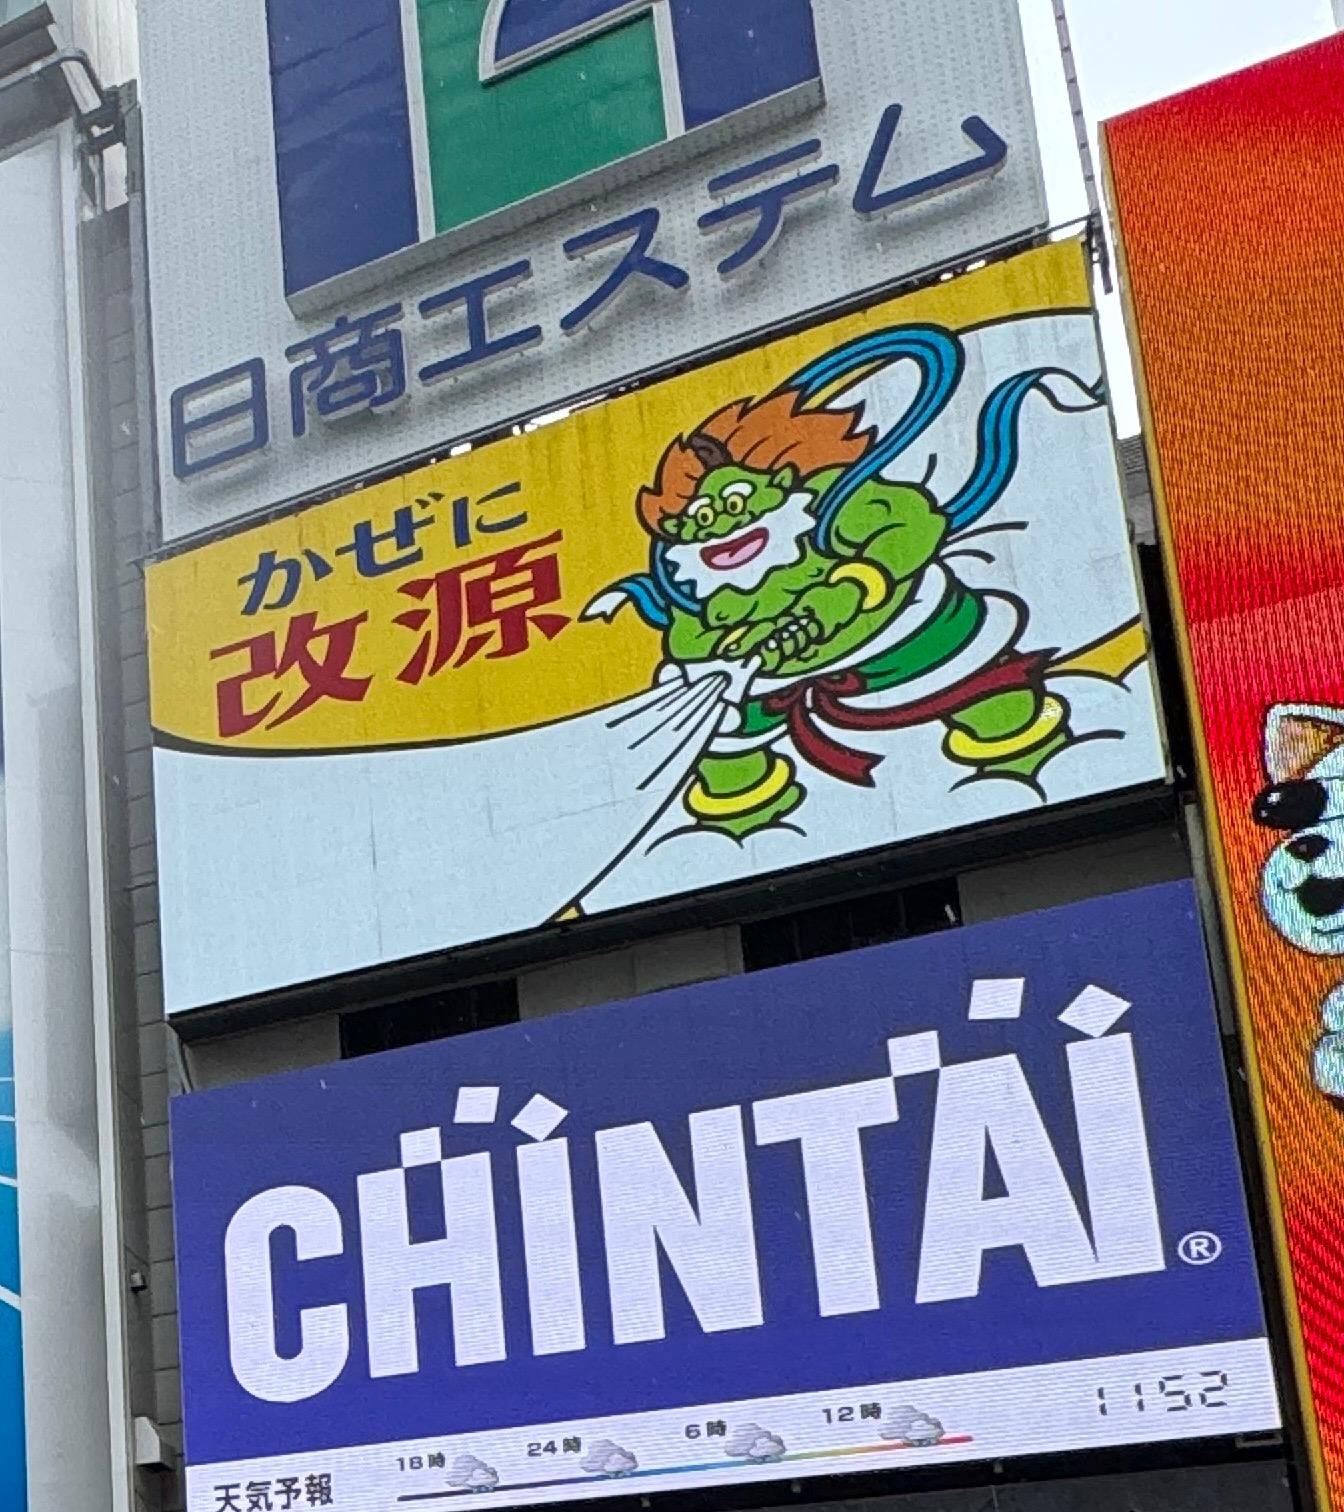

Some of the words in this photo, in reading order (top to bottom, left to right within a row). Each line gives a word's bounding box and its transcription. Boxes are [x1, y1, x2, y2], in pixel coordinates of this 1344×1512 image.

[169, 103, 1009, 482] 日商エステム
[209, 529, 573, 738] 改源
[237, 481, 529, 616] かぜに
